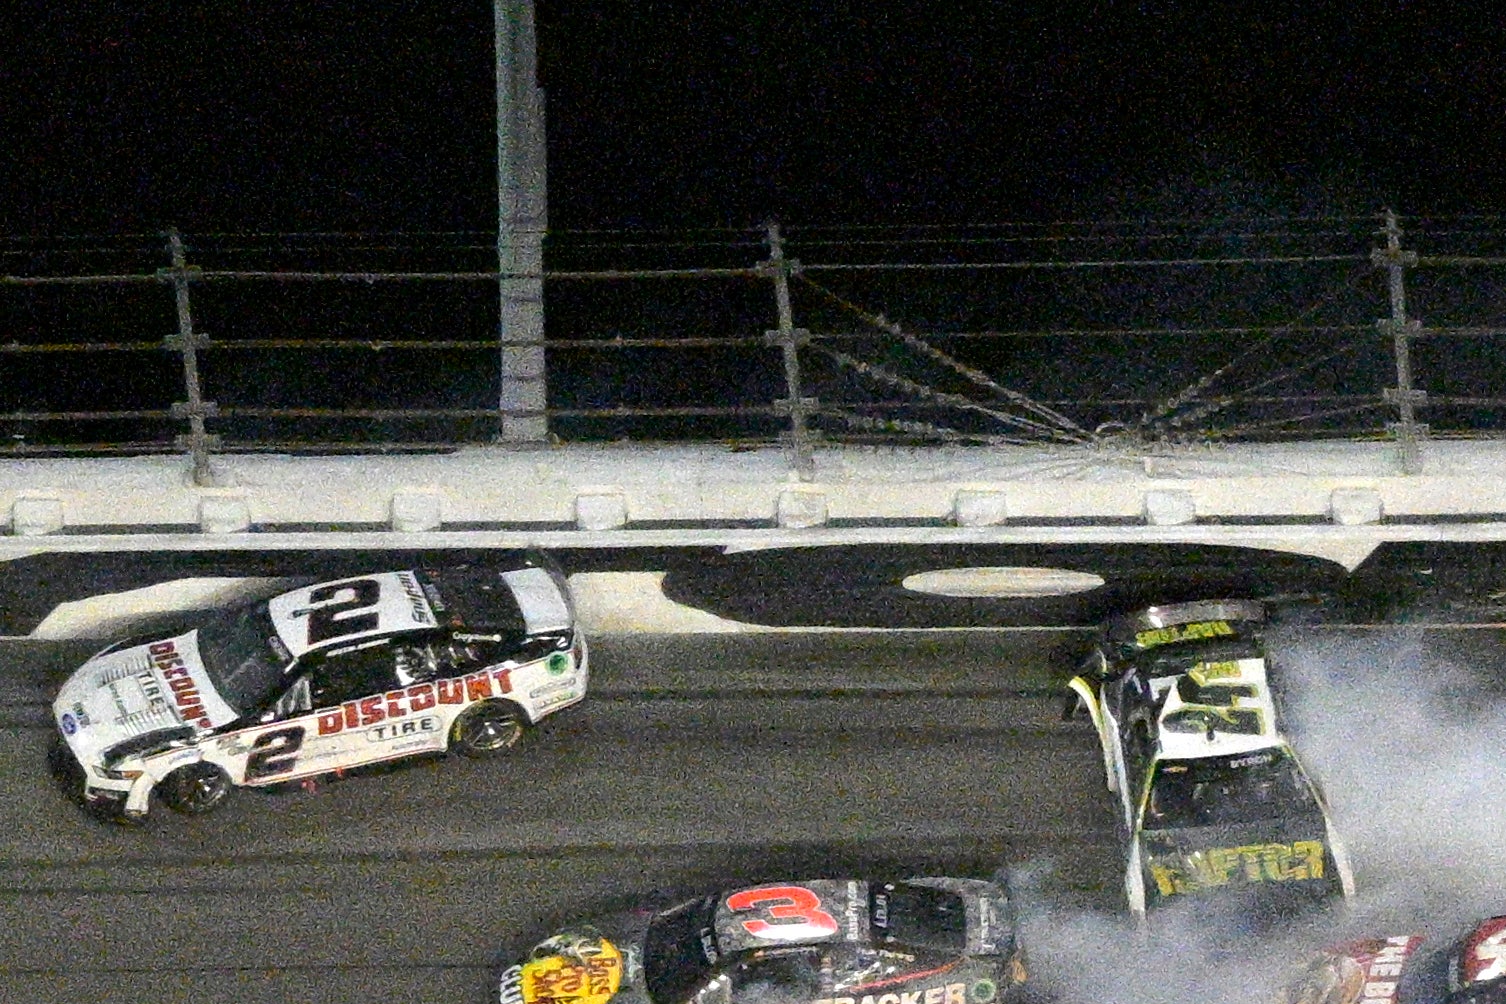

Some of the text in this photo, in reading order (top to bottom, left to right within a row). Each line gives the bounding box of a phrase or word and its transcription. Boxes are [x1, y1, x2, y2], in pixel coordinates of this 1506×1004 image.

[307, 579, 381, 646] 2
[138, 671, 166, 706] TIRE
[317, 668, 513, 736] DISCOUNT
[376, 718, 433, 739] TIRE
[244, 726, 305, 783] 2
[727, 886, 838, 940] 3
[587, 956, 618, 995] Bass
[1369, 935, 1410, 977] THE
